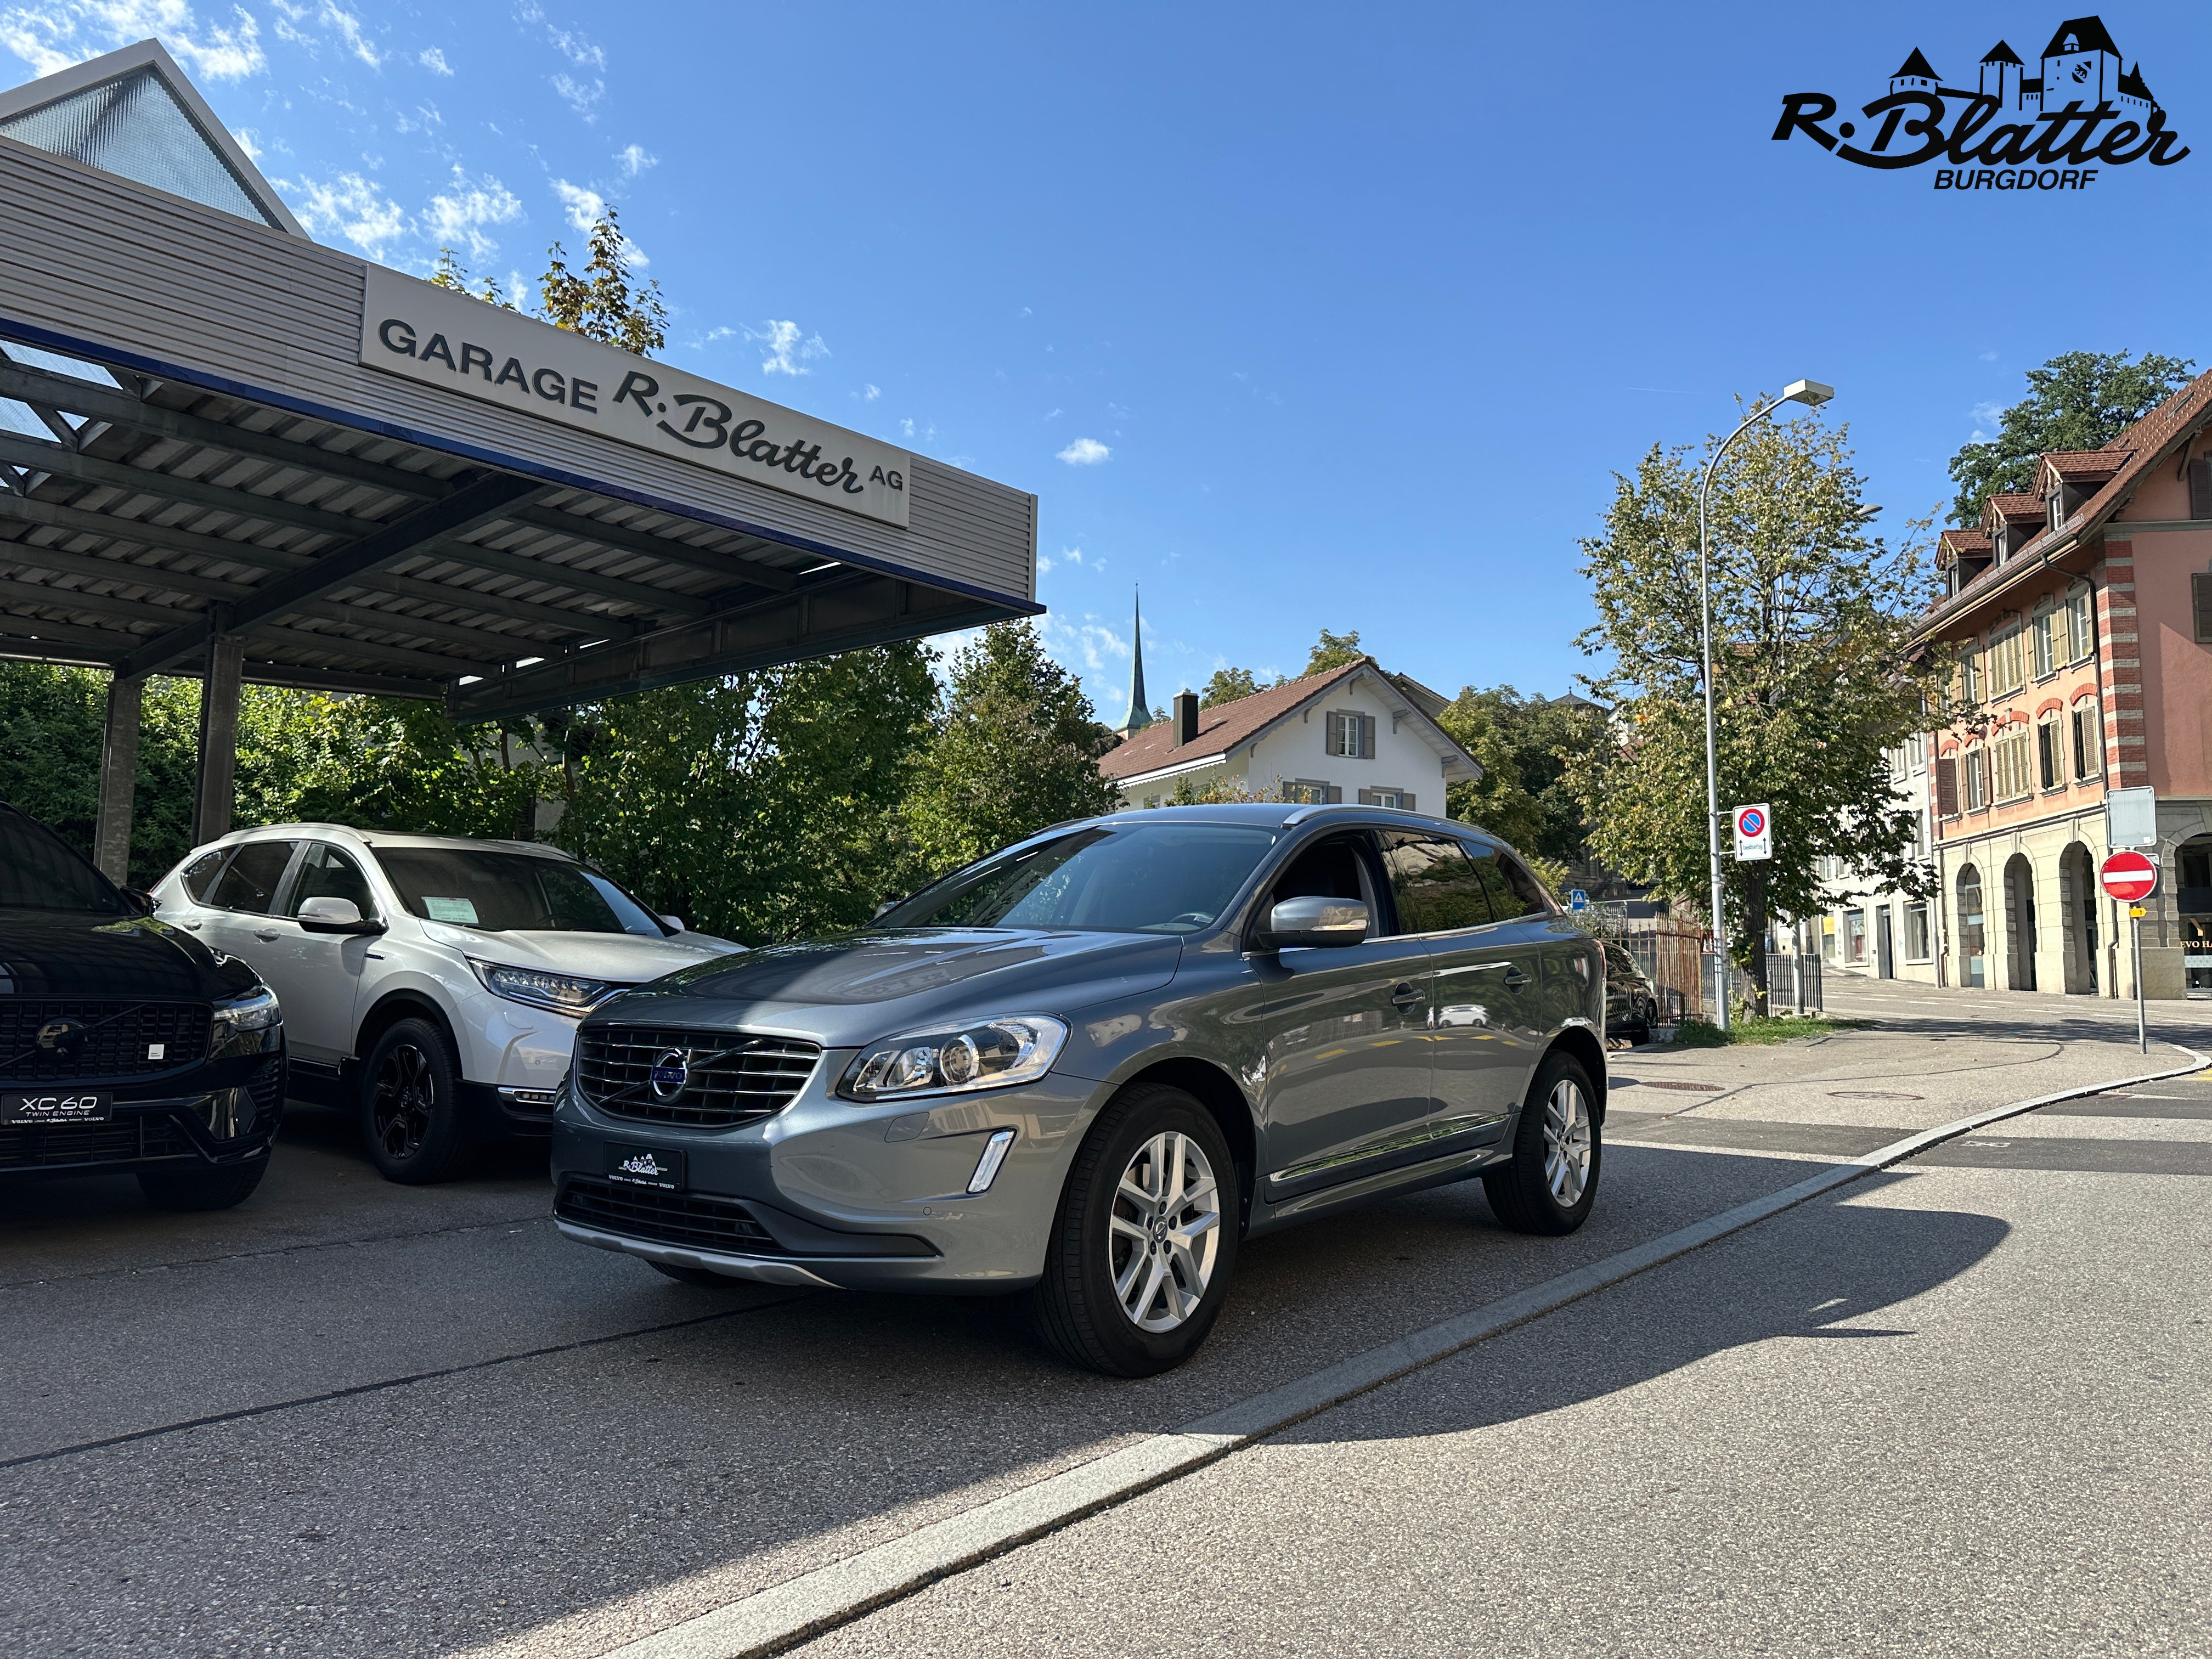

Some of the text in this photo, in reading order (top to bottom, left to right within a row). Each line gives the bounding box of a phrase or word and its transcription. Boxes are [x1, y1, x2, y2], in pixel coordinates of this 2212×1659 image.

[378, 318, 599, 414] GARAGE
[868, 465, 903, 491] AG
[653, 1070, 682, 1079] VOLVO
